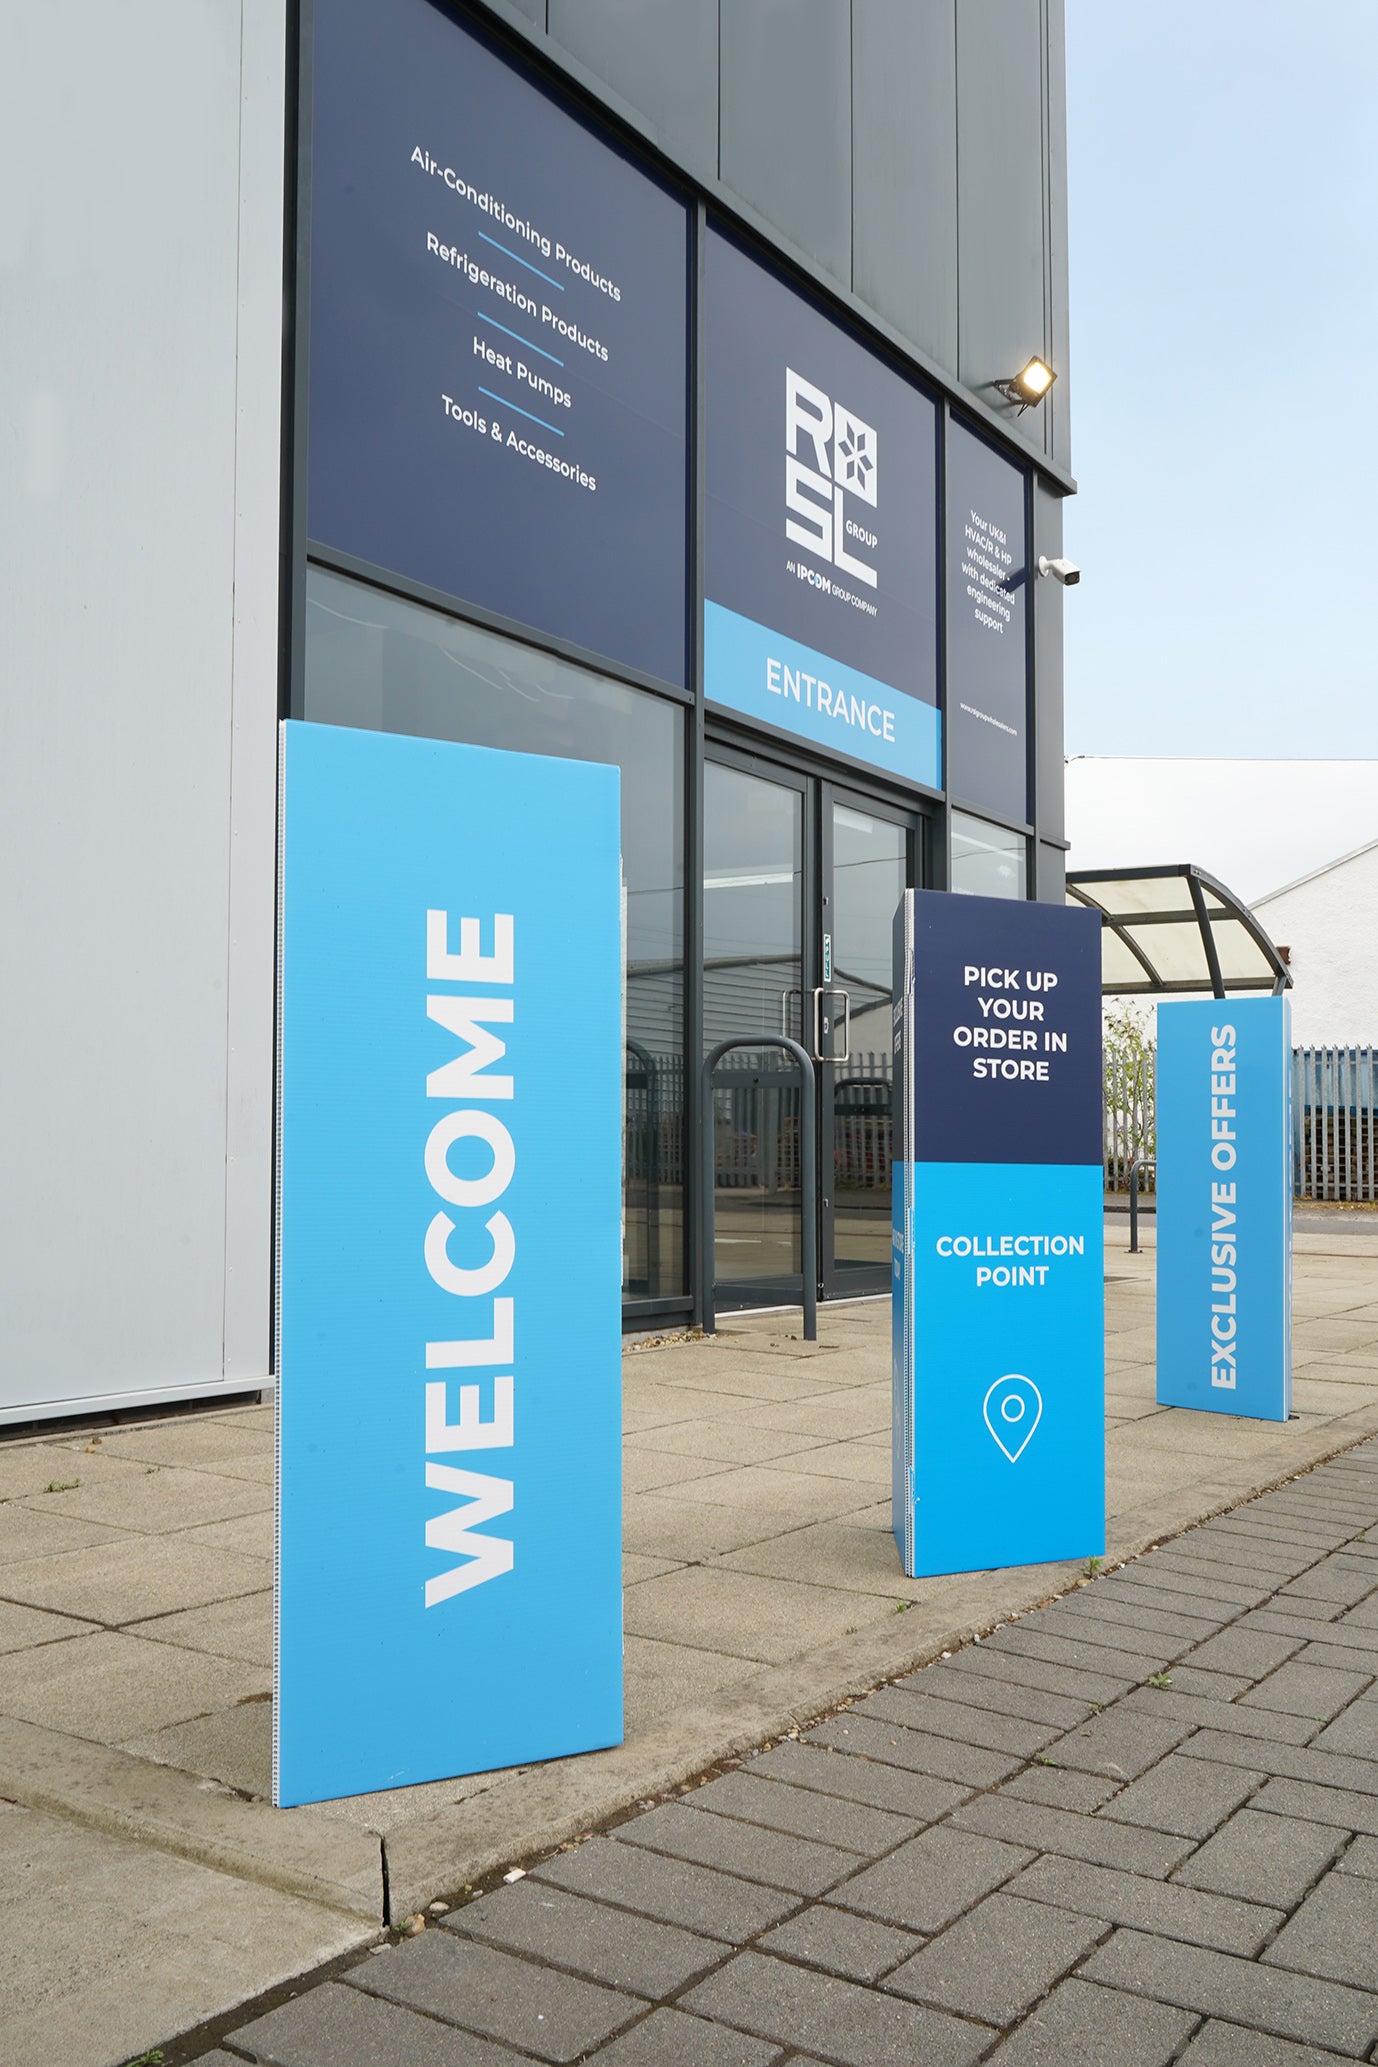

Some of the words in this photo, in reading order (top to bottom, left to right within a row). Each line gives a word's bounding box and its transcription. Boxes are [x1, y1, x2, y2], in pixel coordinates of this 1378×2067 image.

[410, 146, 551, 257] Air-Conditioning
[556, 243, 621, 302] Products
[427, 232, 537, 318] Refrigeration
[542, 305, 609, 362] Products
[473, 336, 512, 375] Heat
[517, 362, 572, 408] Pumps
[442, 394, 487, 435] Tools
[491, 422, 503, 443] &
[507, 431, 596, 491] Accessories
[845, 519, 877, 549] GROUP
[970, 509, 988, 532] Your
[964, 524, 994, 555] HVAC/R
[994, 545, 1001, 560] &
[1001, 550, 1013, 566] HP
[786, 560, 796, 574] AN
[797, 562, 831, 595] IPCOM
[832, 584, 851, 603] GROUP
[851, 594, 878, 617] COMPANY
[961, 561, 979, 581] with
[979, 573, 1016, 605] dedicated
[966, 584, 1011, 623] engineering
[974, 608, 1004, 634] support
[766, 657, 896, 743] ENTRANCE
[963, 966, 1021, 990] PICK
[1026, 971, 1058, 991] UP
[977, 996, 1044, 1021] YOUR
[953, 1026, 1039, 1051] ORDER
[1044, 1031, 1068, 1053] IN
[972, 1057, 1050, 1081] STORE
[1211, 1023, 1237, 1171] OFFERS
[424, 908, 516, 1609] WELCOME
[935, 1235, 1085, 1257] COLLECTION
[976, 1265, 1050, 1287] POINT
[1211, 1181, 1237, 1390] EXCLUSIVE
